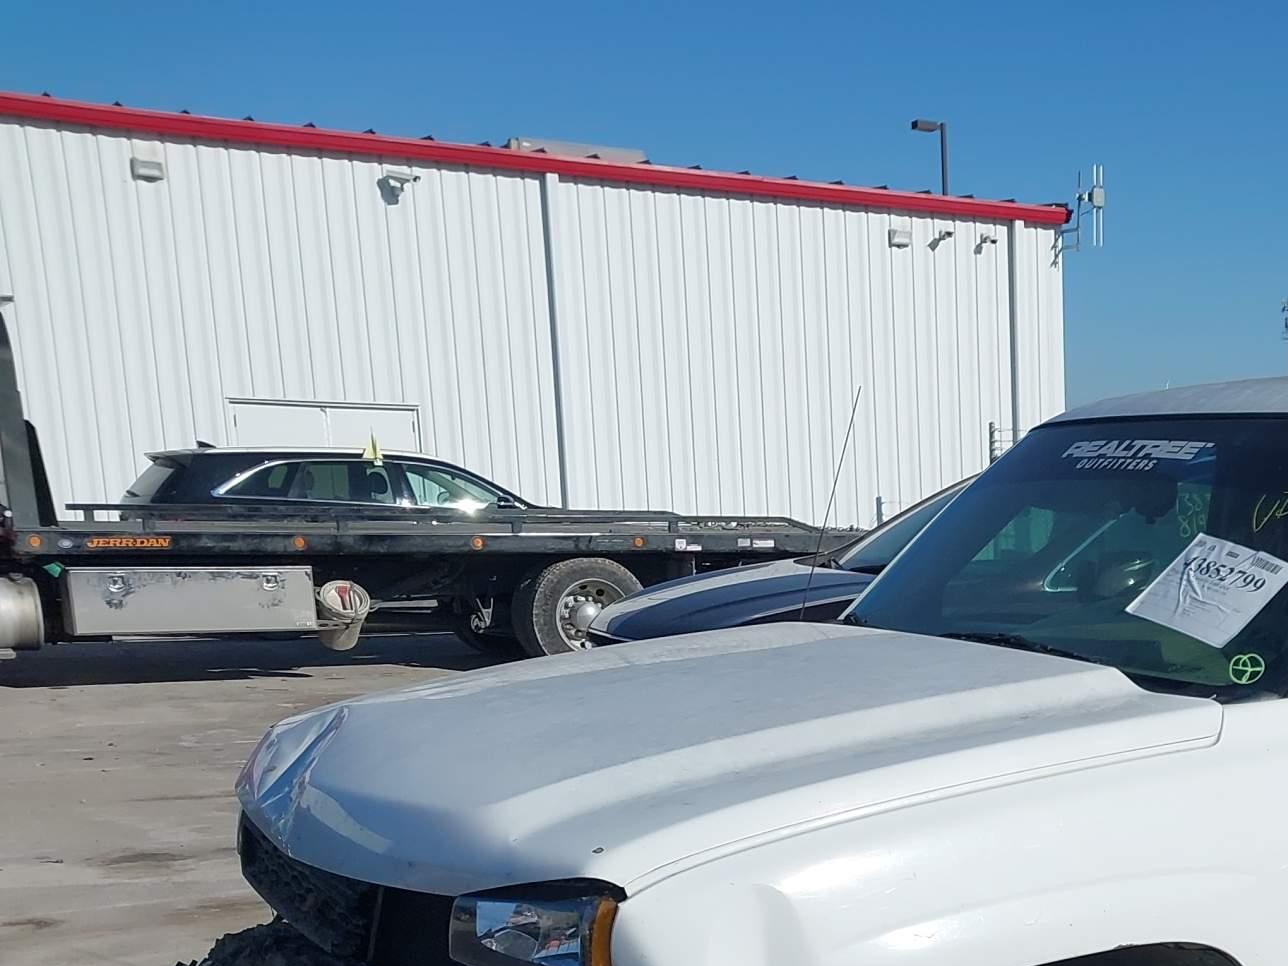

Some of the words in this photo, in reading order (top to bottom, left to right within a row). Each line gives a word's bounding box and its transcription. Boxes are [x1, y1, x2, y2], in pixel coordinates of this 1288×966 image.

[1061, 440, 1208, 460] REALTREE
[1076, 459, 1158, 471] OUTFITTERS
[1184, 556, 1266, 593] 43852799
